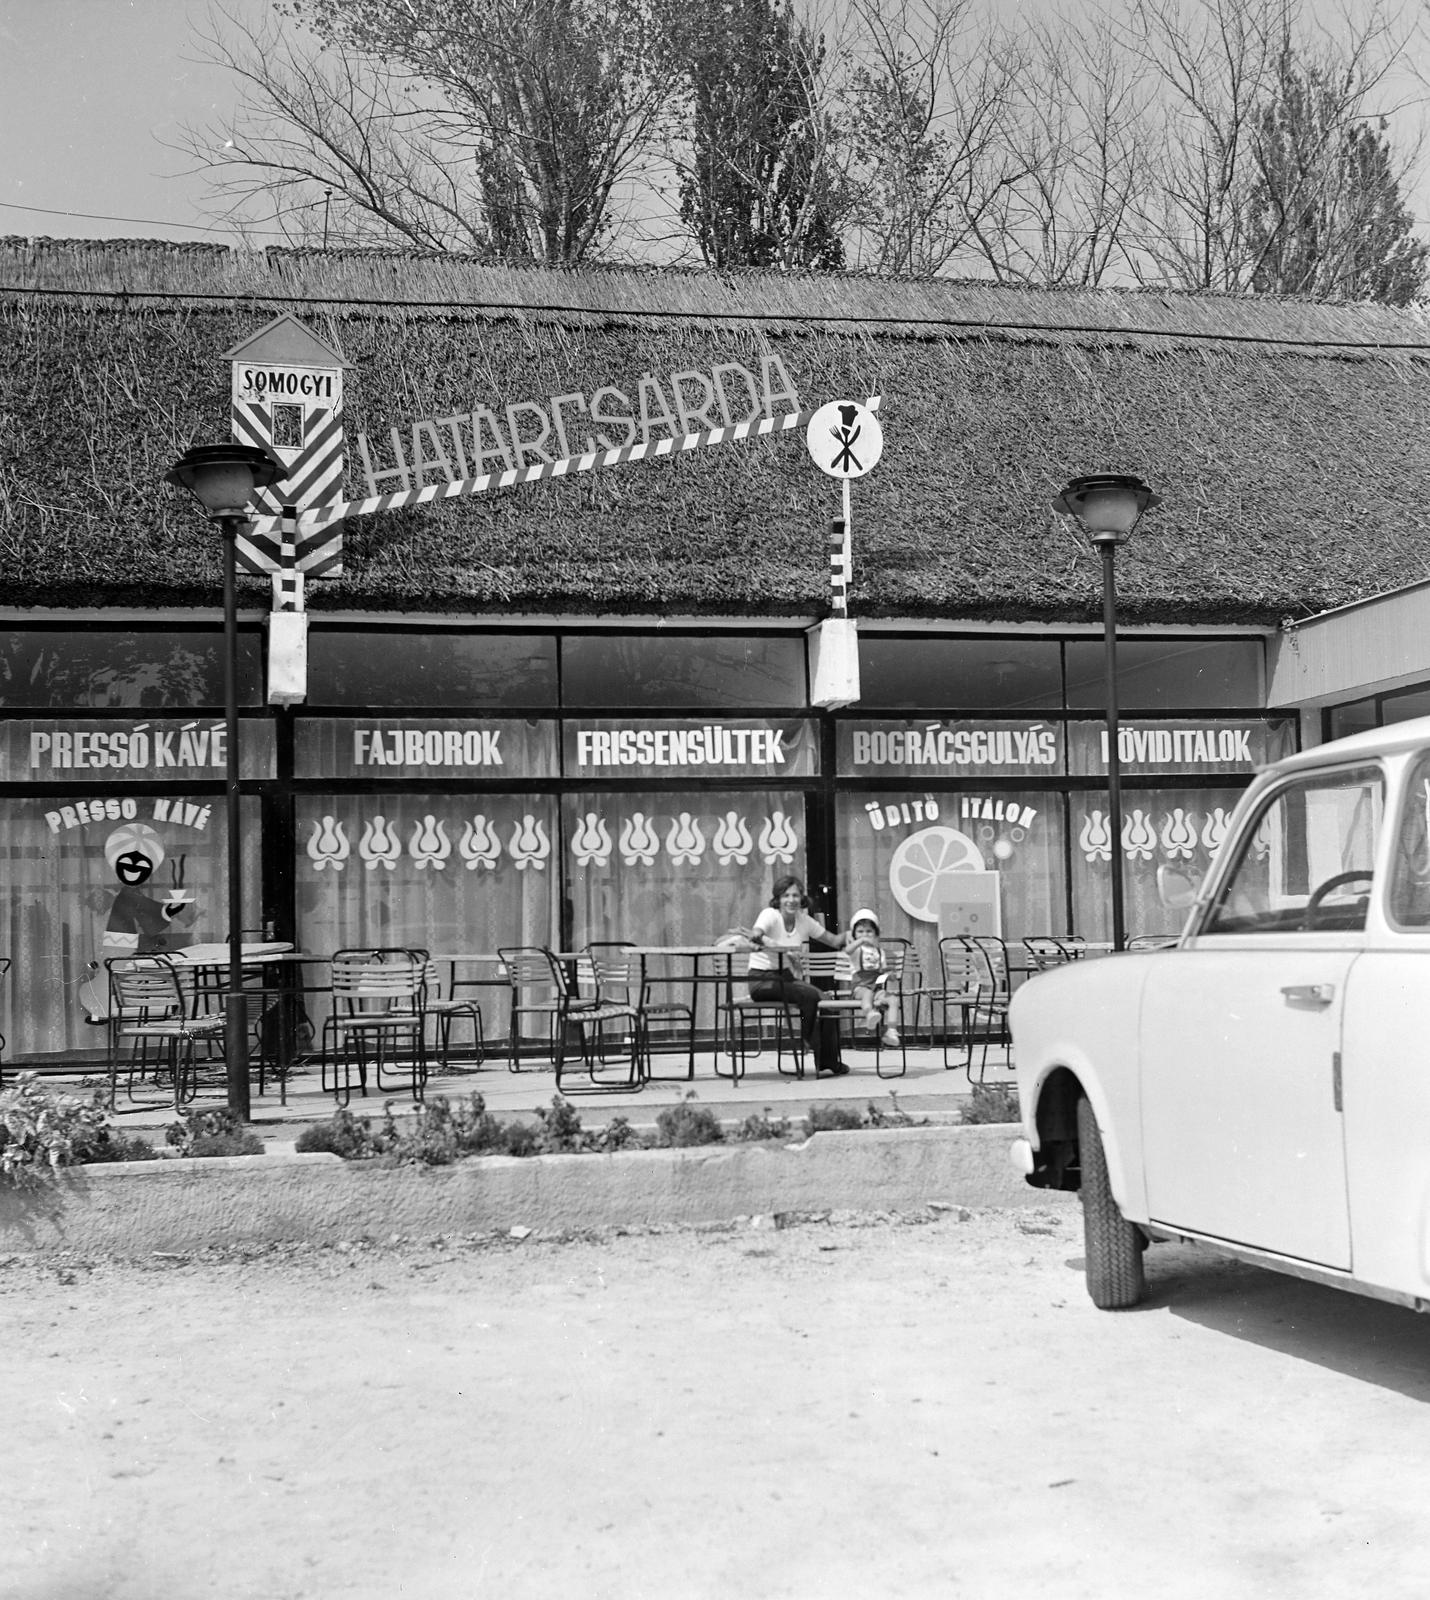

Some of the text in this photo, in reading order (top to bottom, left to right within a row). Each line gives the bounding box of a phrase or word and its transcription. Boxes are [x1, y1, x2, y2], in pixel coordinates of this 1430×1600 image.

[243, 369, 332, 398] SOMOGYI
[357, 354, 802, 497] HATÁRCSÁRDA
[30, 722, 228, 769] PRESSÓ KÁVÉ
[354, 729, 504, 766] FAJBOROK
[577, 725, 786, 766] FRISSENSÜLTEK
[853, 723, 1057, 765] BOGRÁCSGULYÁS
[44, 797, 212, 834] PRESSO KÁVÉ
